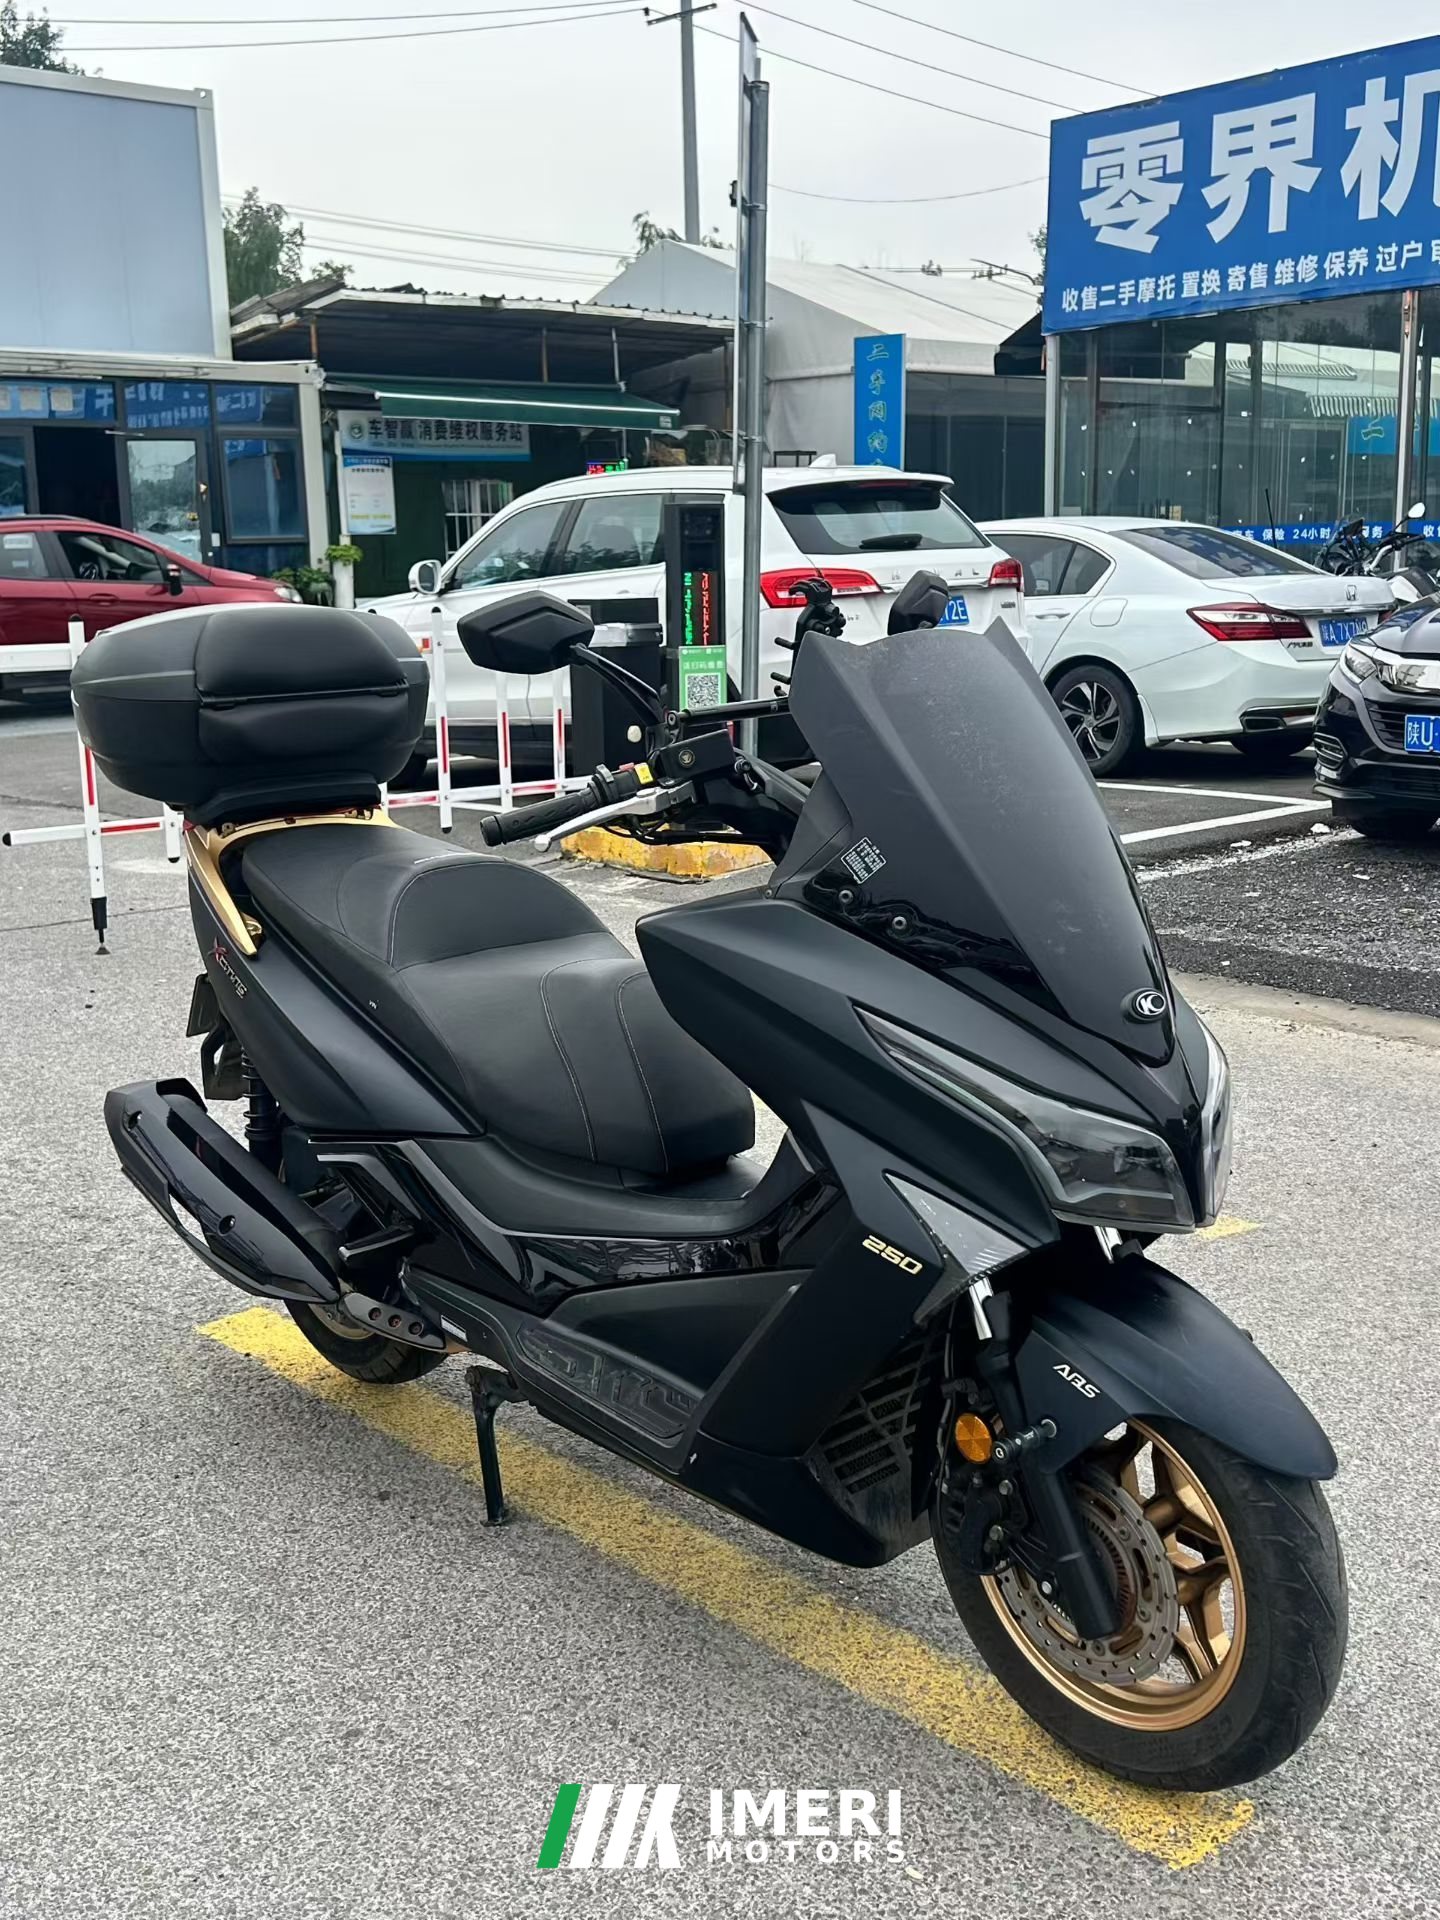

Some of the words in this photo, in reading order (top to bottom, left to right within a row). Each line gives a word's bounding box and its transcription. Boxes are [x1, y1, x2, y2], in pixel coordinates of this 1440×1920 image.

[1062, 275, 1175, 313] 收售二手摩托
[1181, 268, 1221, 297] 置换
[1228, 263, 1268, 292] 寄售
[1274, 255, 1318, 285] 维修
[1324, 247, 1369, 278] 保养
[1376, 240, 1422, 273] 过户
[1293, 526, 1332, 540] 24小时
[862, 1234, 923, 1275] 250
[1052, 1364, 1101, 1398] ABS
